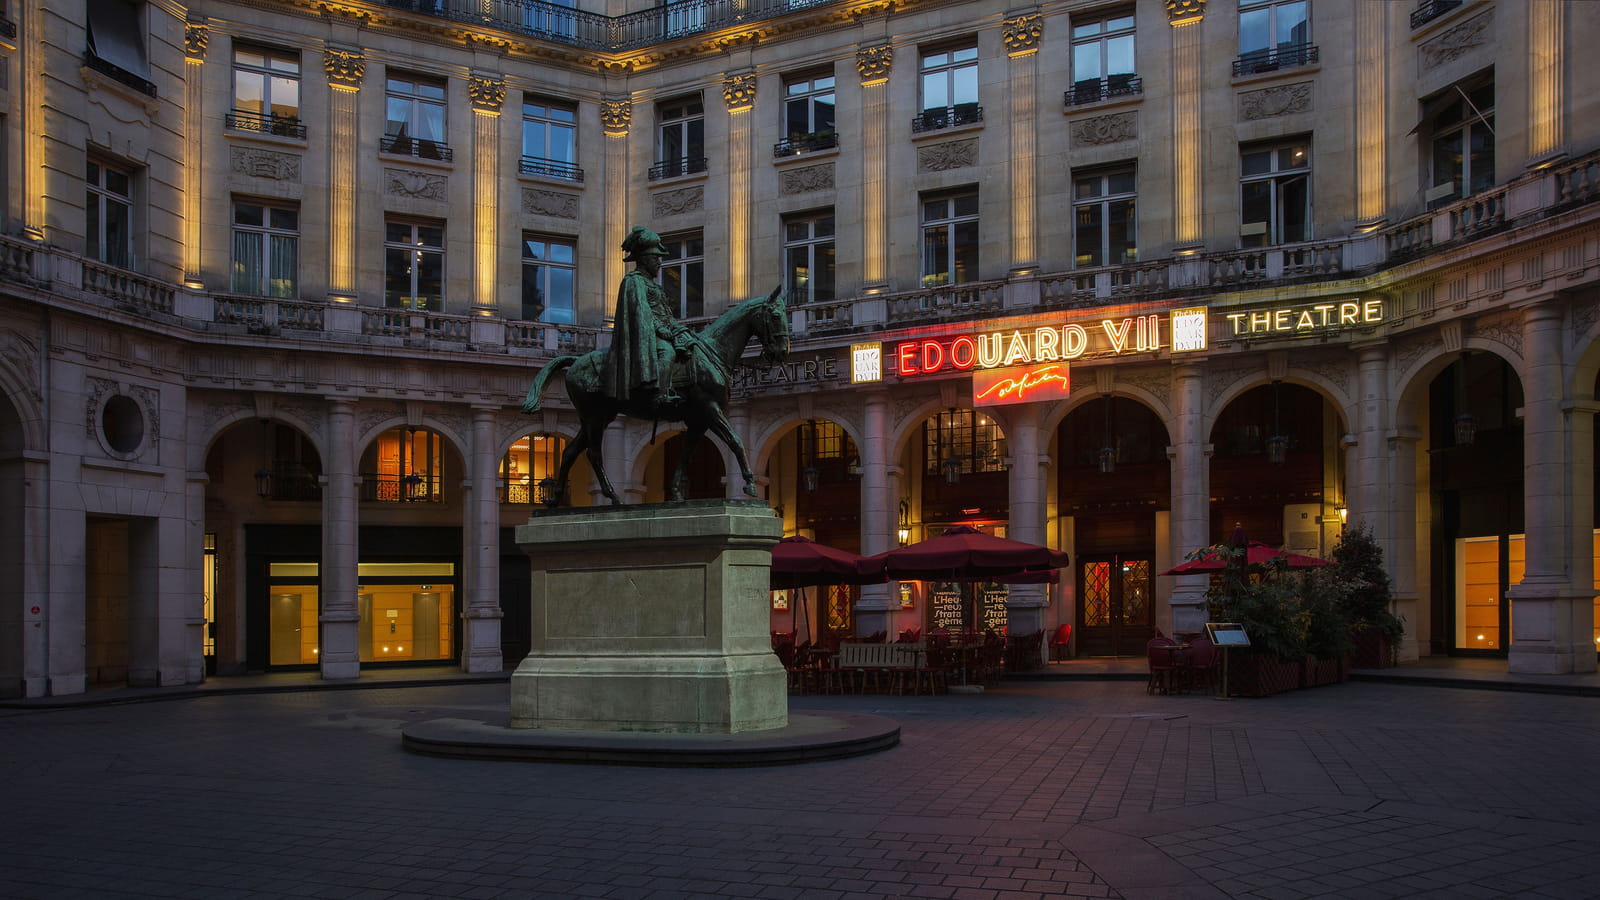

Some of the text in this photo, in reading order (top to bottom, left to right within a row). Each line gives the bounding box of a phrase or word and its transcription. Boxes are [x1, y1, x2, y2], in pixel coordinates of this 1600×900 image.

[1226, 300, 1383, 336] THEATRE
[897, 314, 1160, 377] EDOUARD VII
[731, 357, 838, 386] THEATRE
